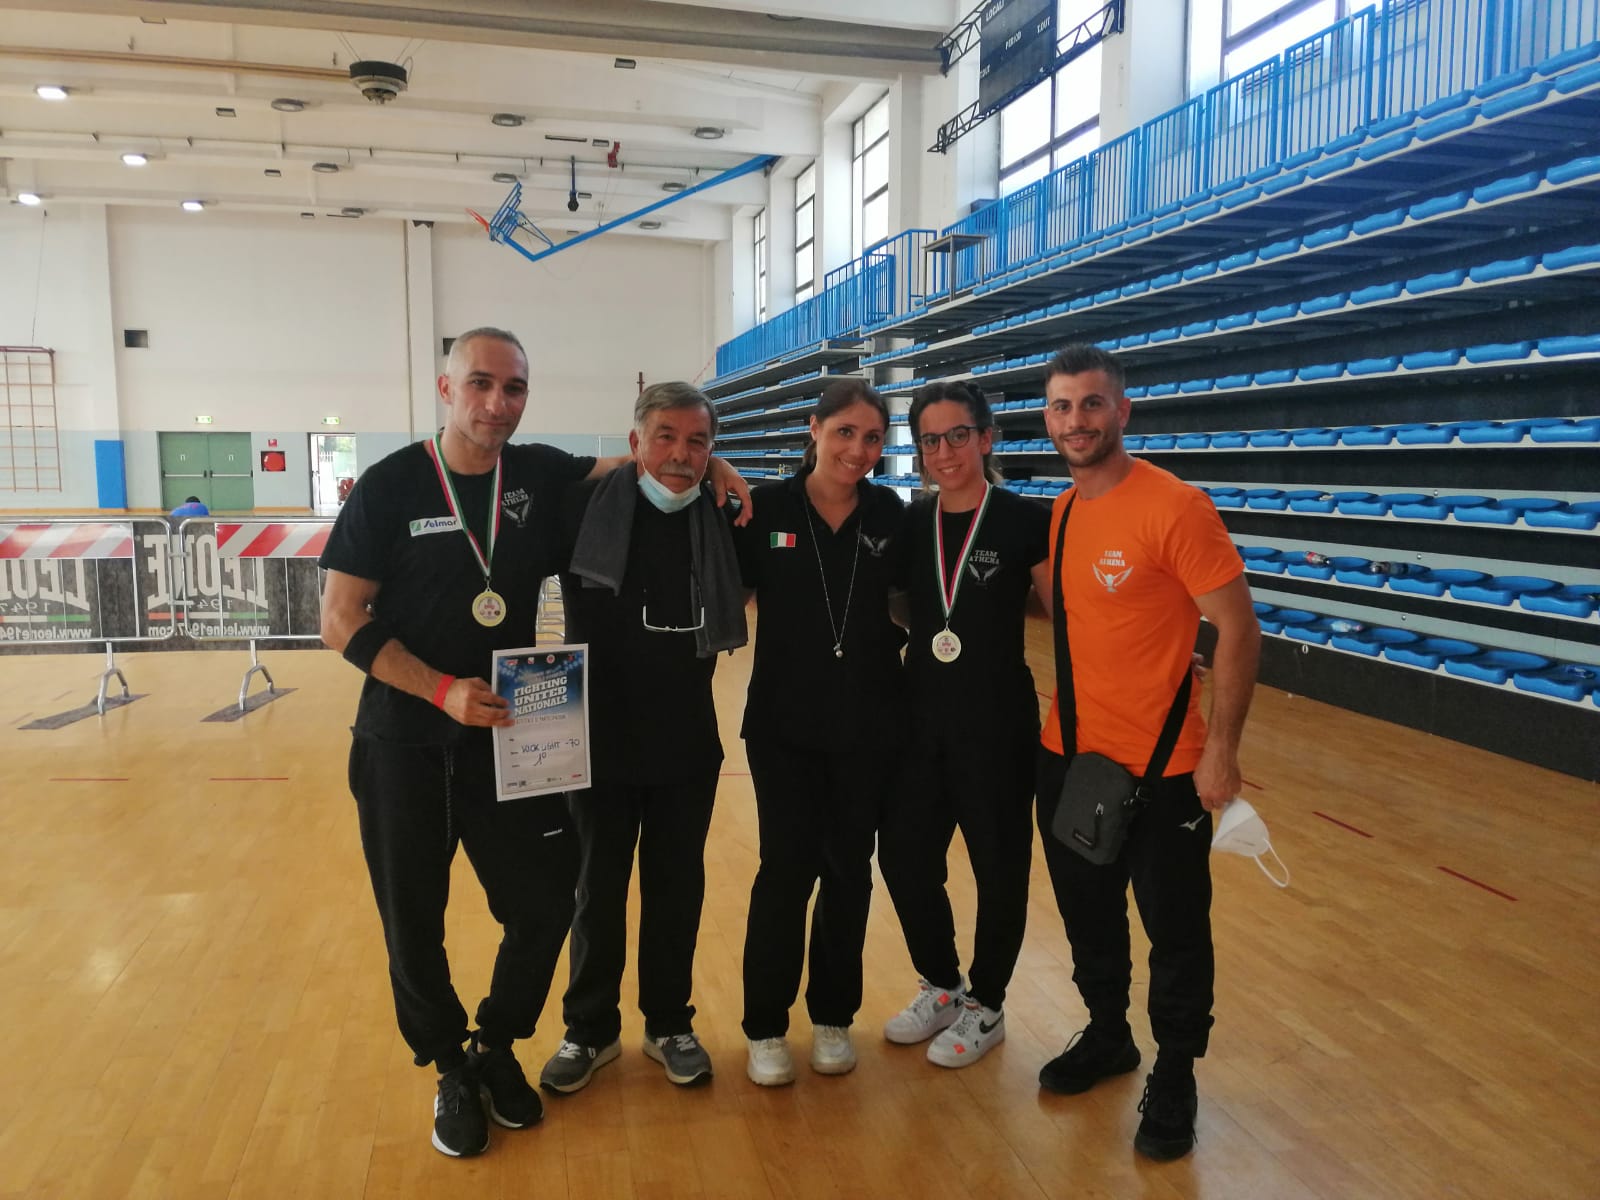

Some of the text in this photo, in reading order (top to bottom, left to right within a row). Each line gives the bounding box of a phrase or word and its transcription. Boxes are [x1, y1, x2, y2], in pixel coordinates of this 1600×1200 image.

[1005, 31, 1022, 50] PERIOD
[974, 550, 998, 558] TEAM
[514, 676, 567, 697] FIGHTING
[514, 686, 567, 706] UNITED
[514, 695, 568, 717] NATIONALS
